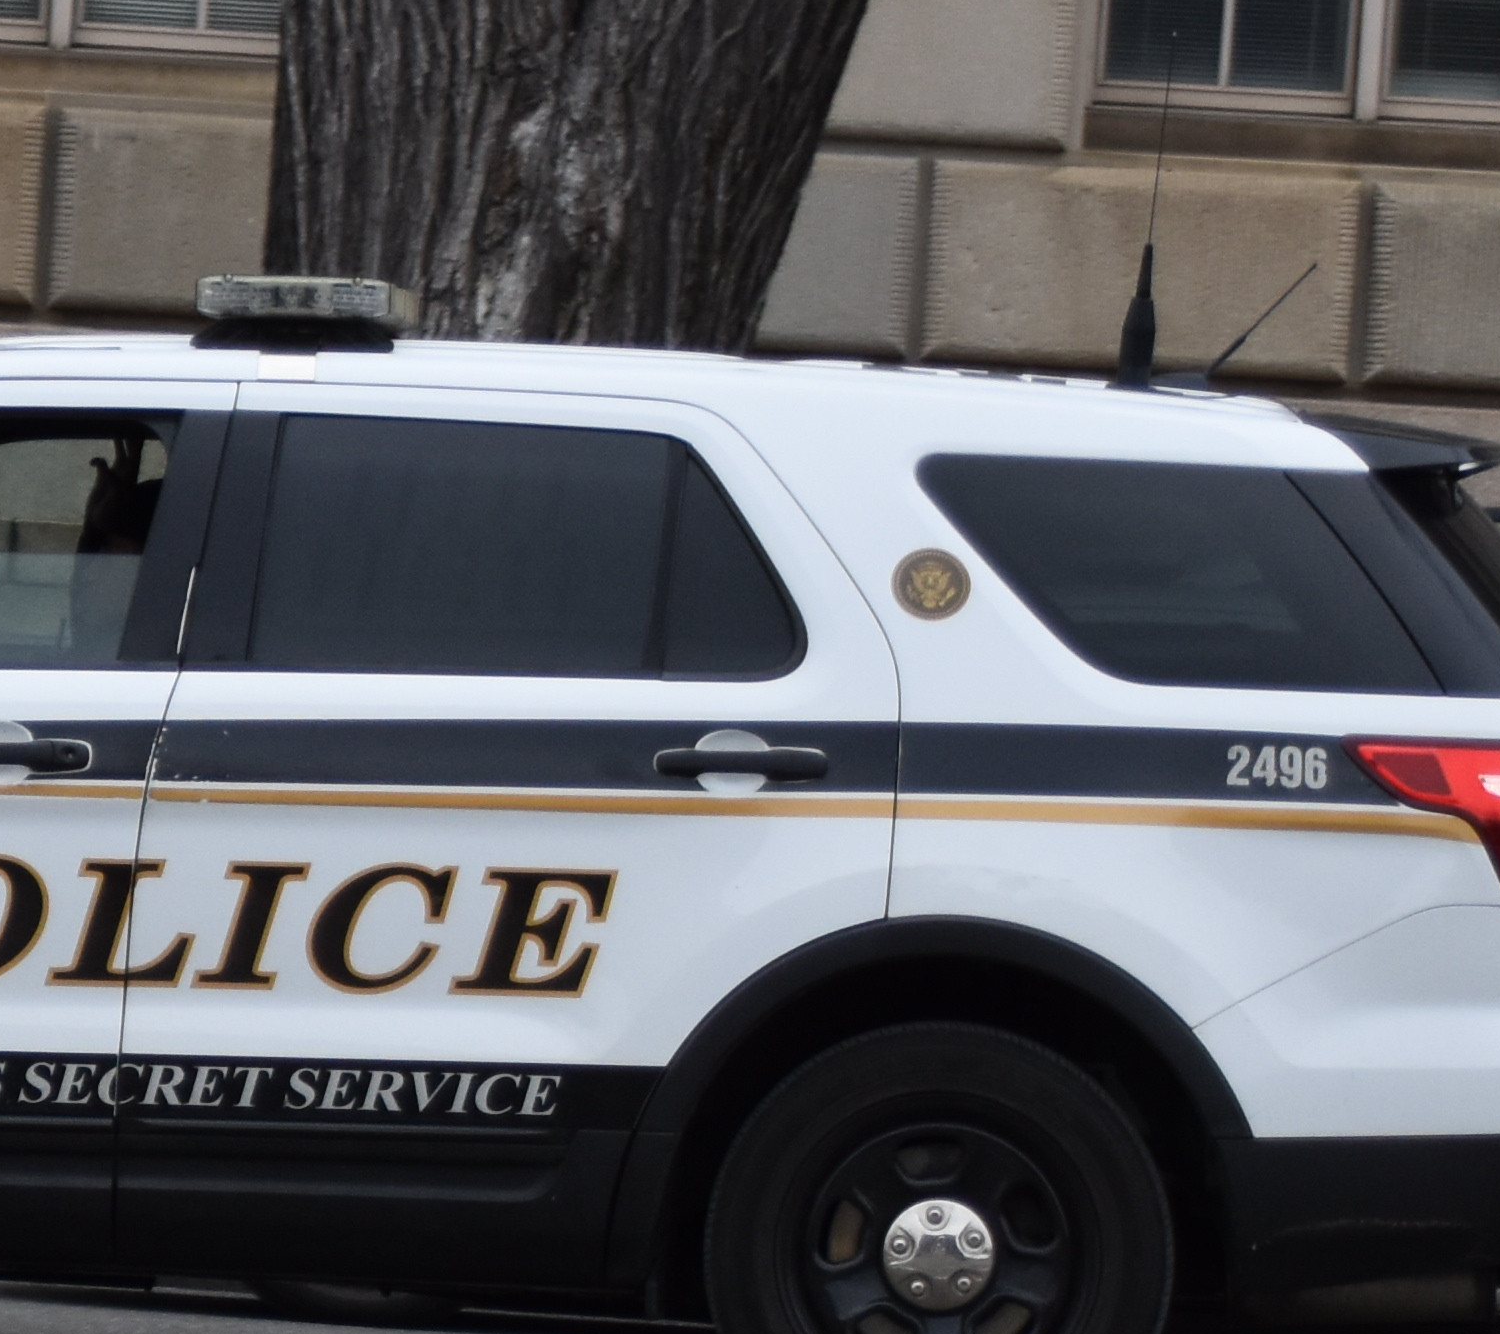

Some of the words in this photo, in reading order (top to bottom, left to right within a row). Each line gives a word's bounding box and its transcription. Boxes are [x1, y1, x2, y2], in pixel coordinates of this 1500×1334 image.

[1226, 744, 1328, 790] 2496
[18, 1060, 275, 1110] SECRET
[284, 1067, 562, 1117] SERVICE
